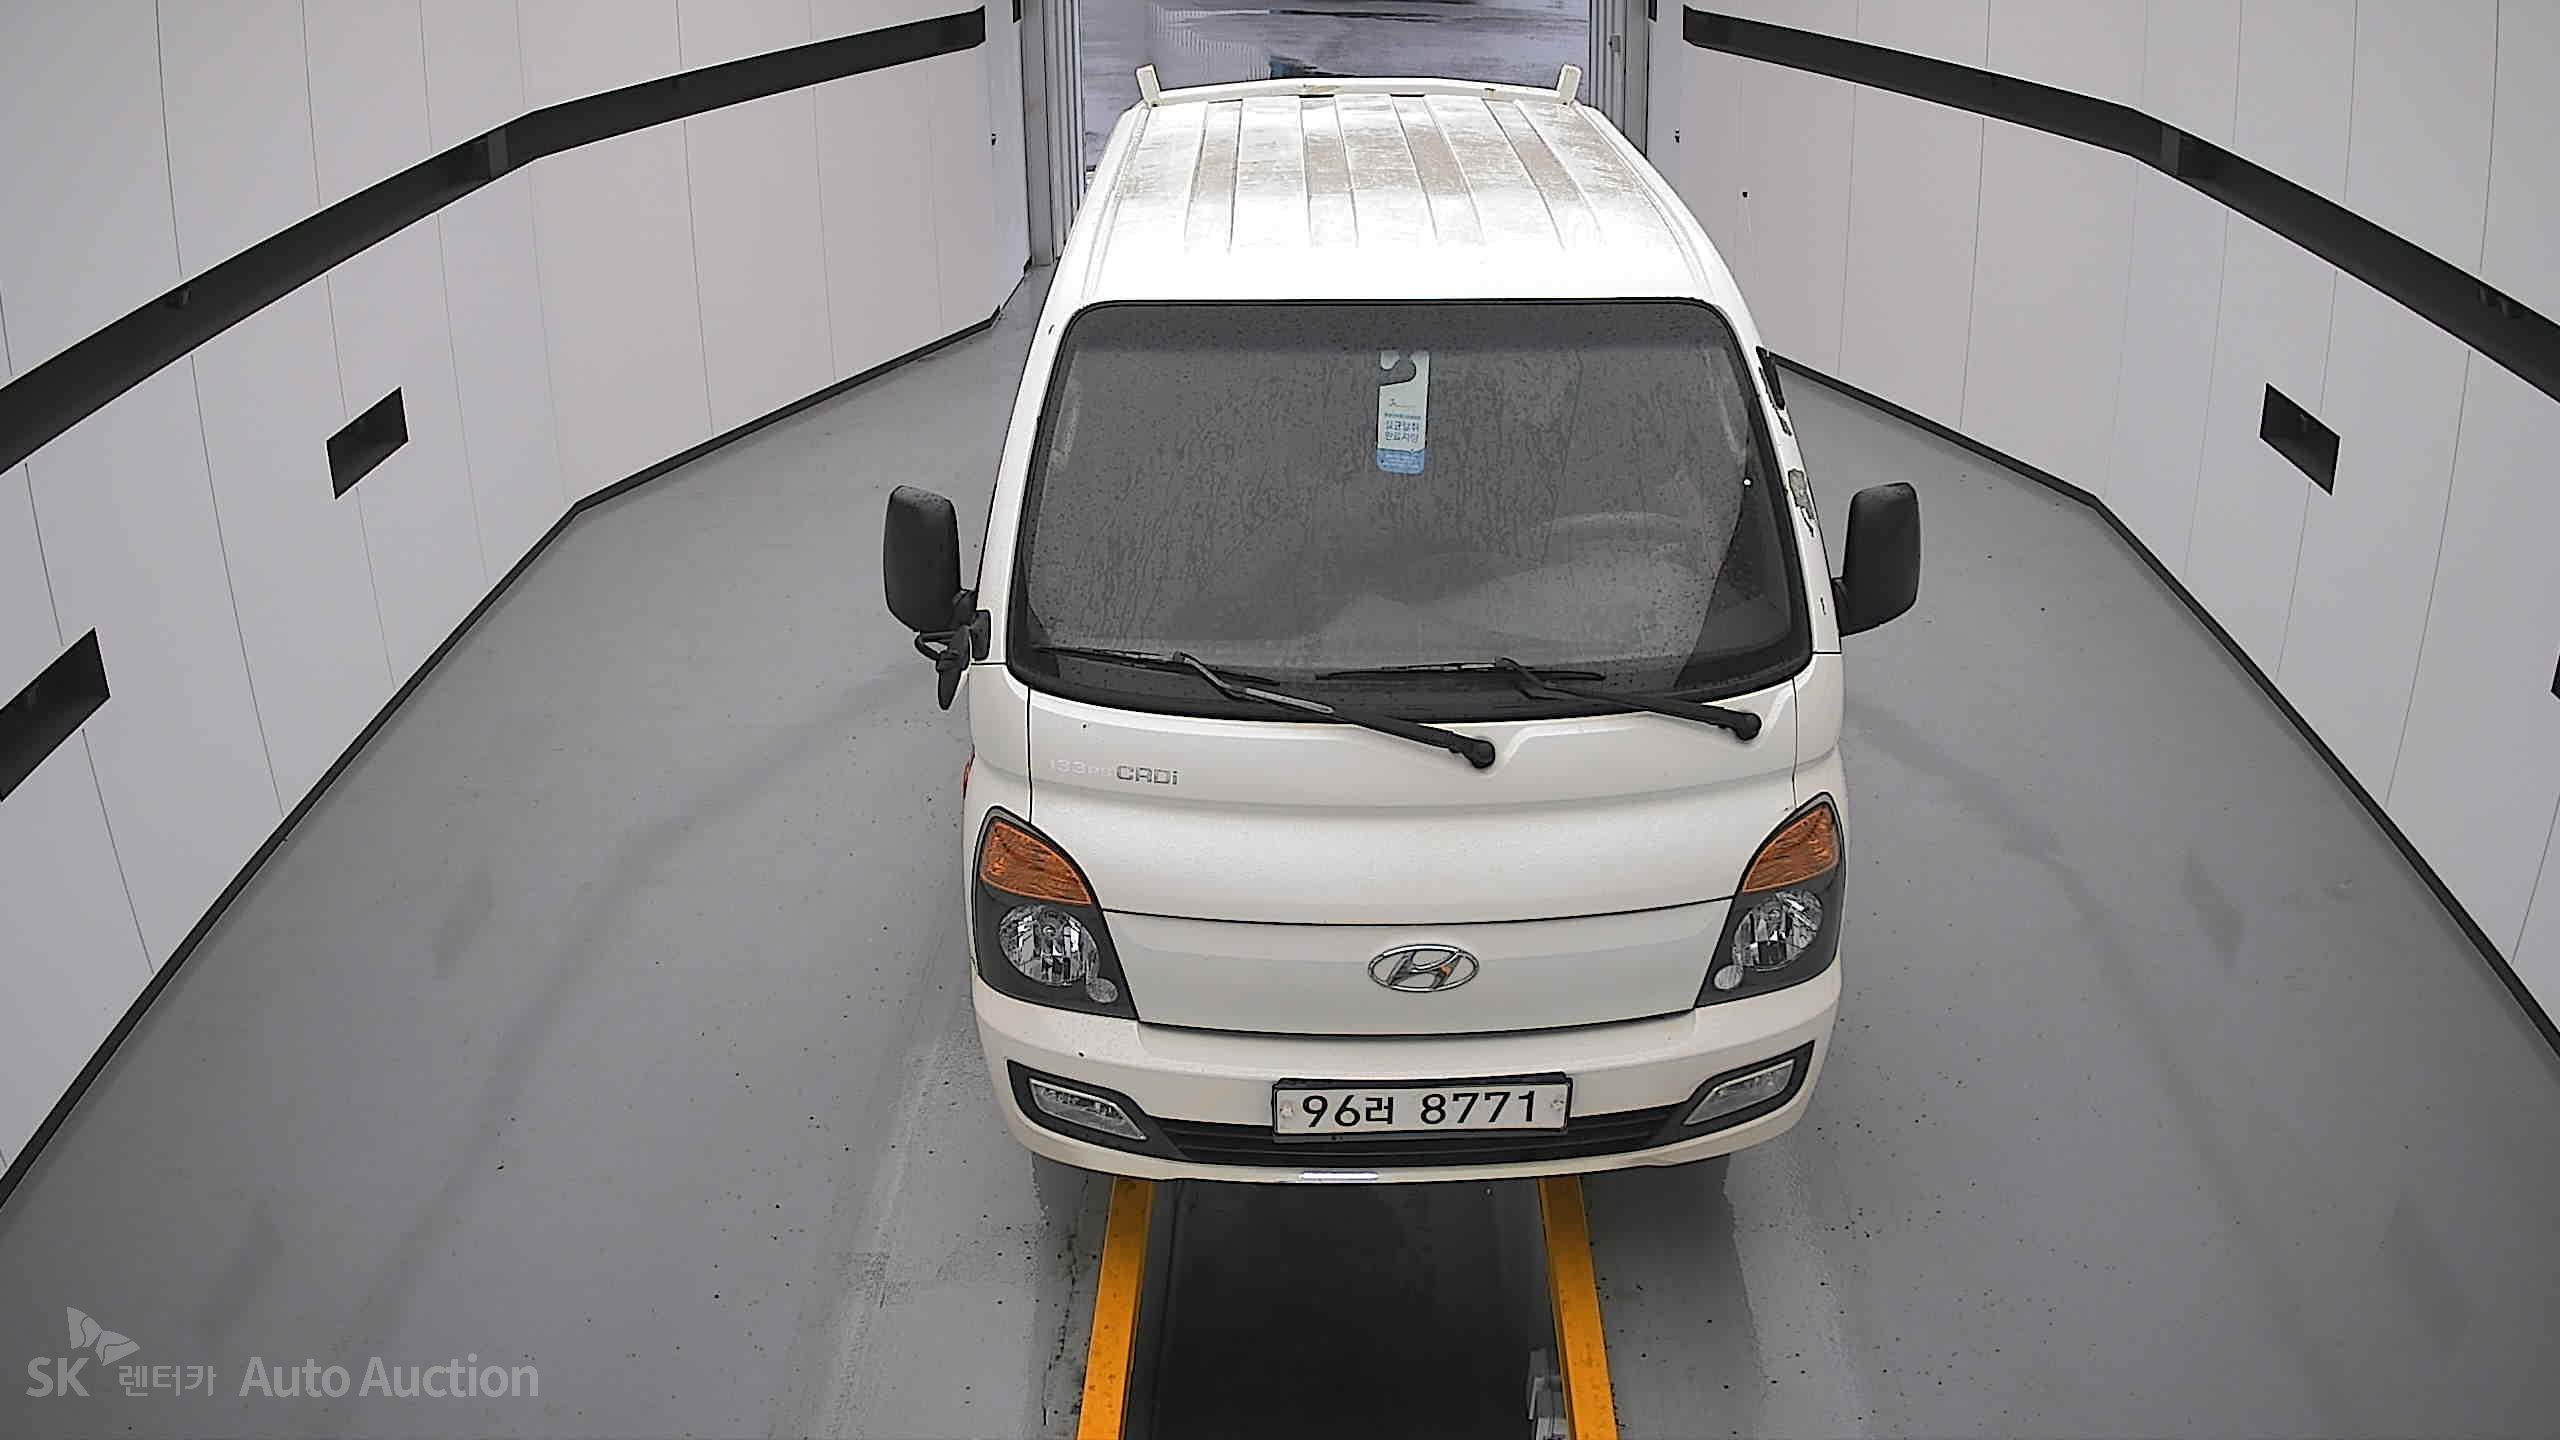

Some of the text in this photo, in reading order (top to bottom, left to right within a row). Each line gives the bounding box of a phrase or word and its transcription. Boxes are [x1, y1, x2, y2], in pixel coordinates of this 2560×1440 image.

[1116, 765, 1178, 785] CRDi
[1302, 1090, 1536, 1128] 96러 8771
